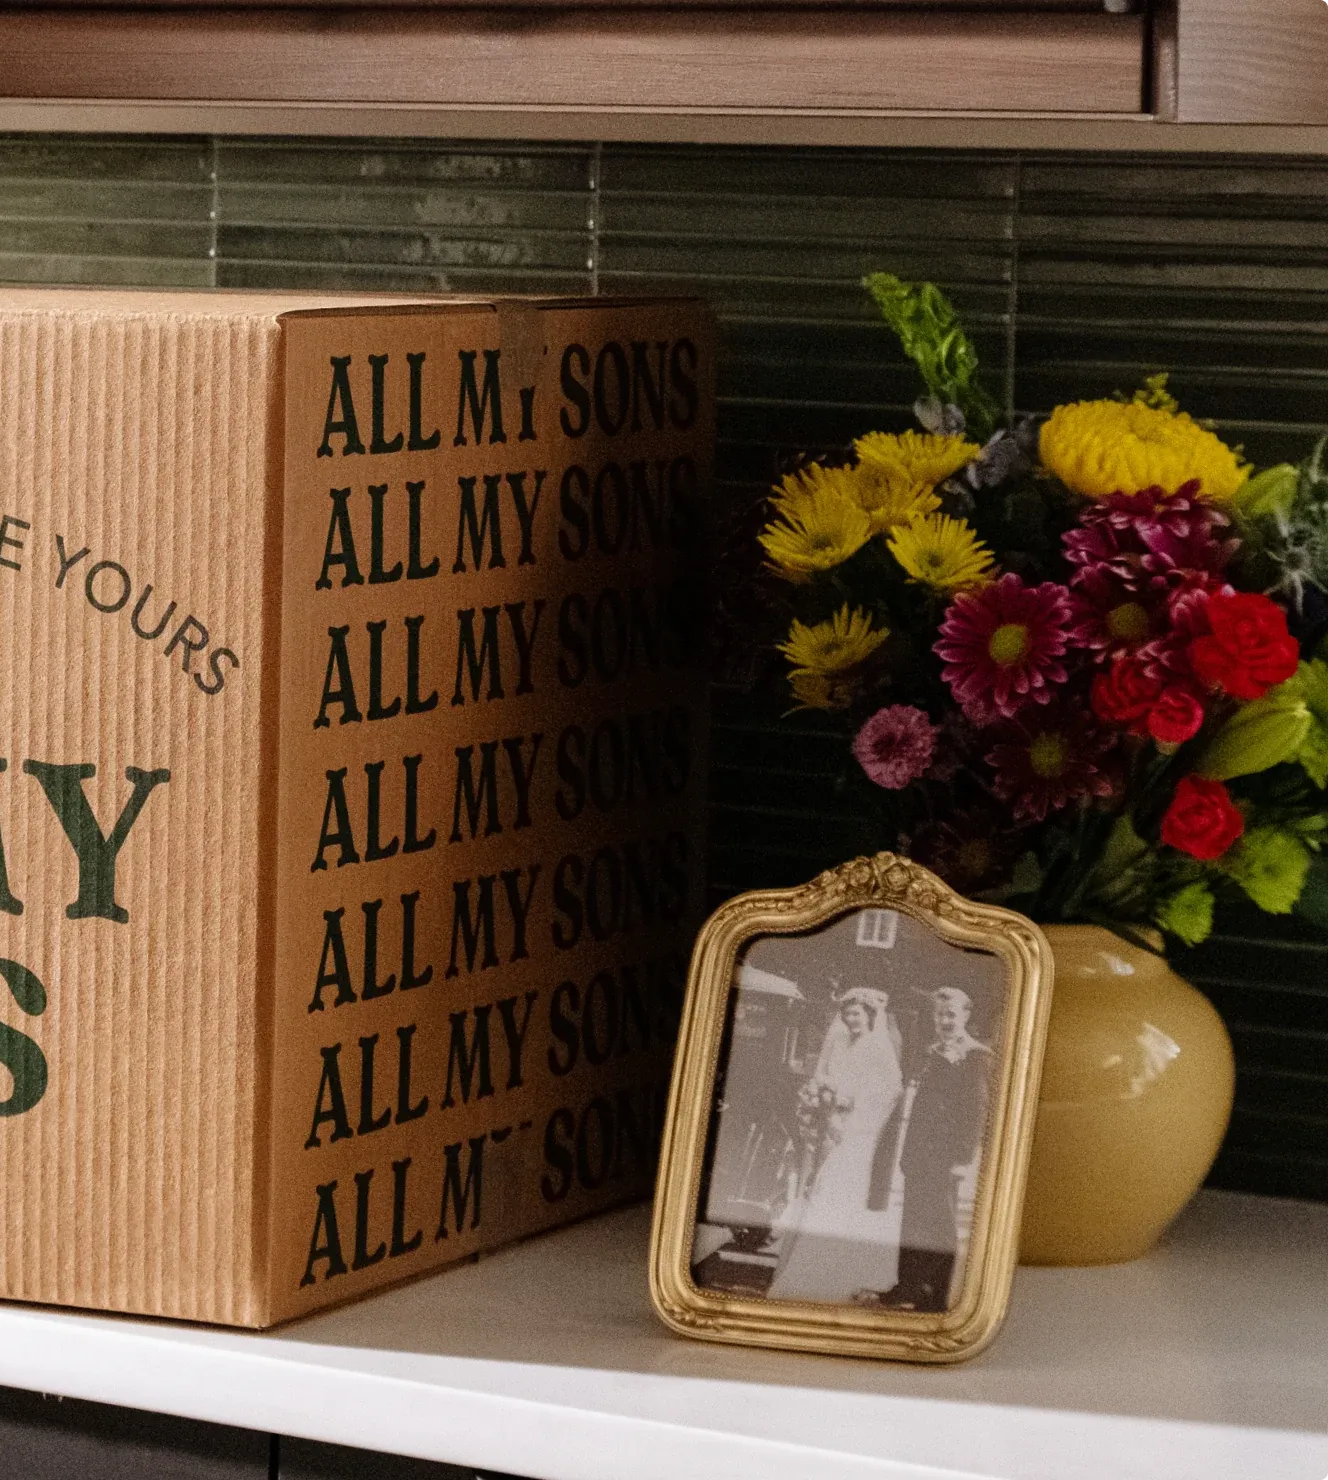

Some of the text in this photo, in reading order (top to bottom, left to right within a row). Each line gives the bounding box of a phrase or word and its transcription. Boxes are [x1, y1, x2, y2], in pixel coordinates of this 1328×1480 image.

[317, 351, 441, 458] ALL
[560, 338, 699, 438] SONS
[315, 480, 441, 590] ALL
[452, 470, 548, 574] MY
[53, 533, 240, 697] YOURS
[313, 615, 438, 729] ALL
[450, 600, 546, 706] MY
[310, 754, 437, 873] ALL
[449, 733, 544, 844] MY
[308, 890, 433, 1014] ALL
[445, 863, 541, 979] MY
[304, 1023, 429, 1149] ALL
[441, 991, 539, 1110] MY
[300, 1081, 666, 1289] ALL M SON
